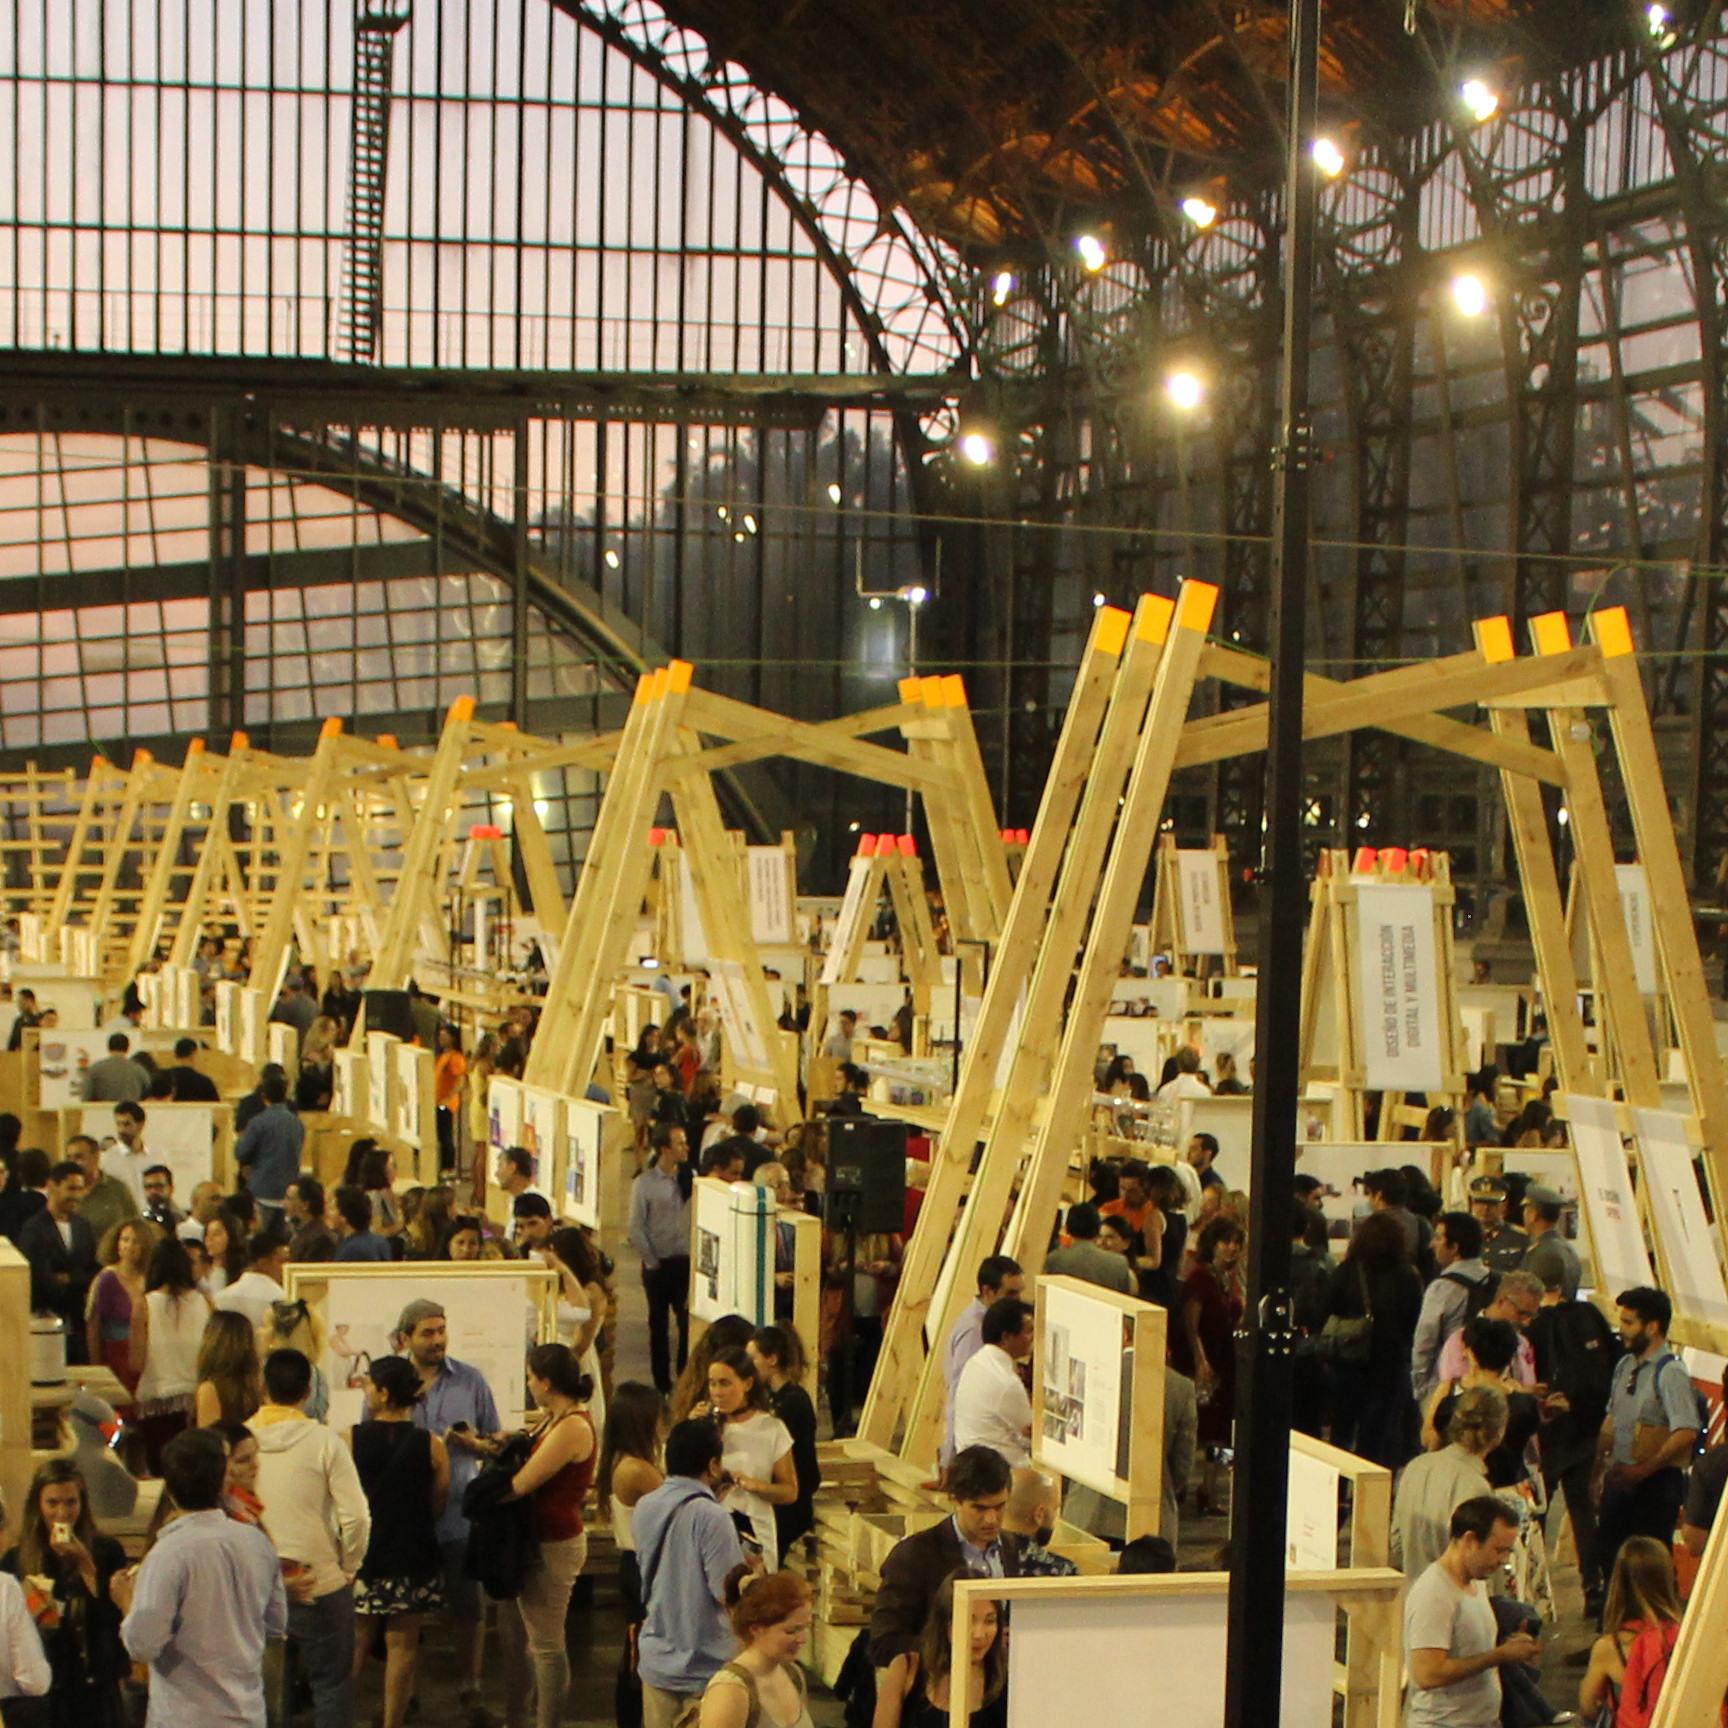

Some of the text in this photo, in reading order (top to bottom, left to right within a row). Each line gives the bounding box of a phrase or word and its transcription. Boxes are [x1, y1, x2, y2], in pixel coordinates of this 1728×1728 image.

[1401, 925, 1417, 993] MULTIMEDIA
[1384, 1000, 1398, 1015] DE
[1406, 1006, 1421, 1048] DIGITAL
[1382, 1017, 1400, 1058] DISEÑO
